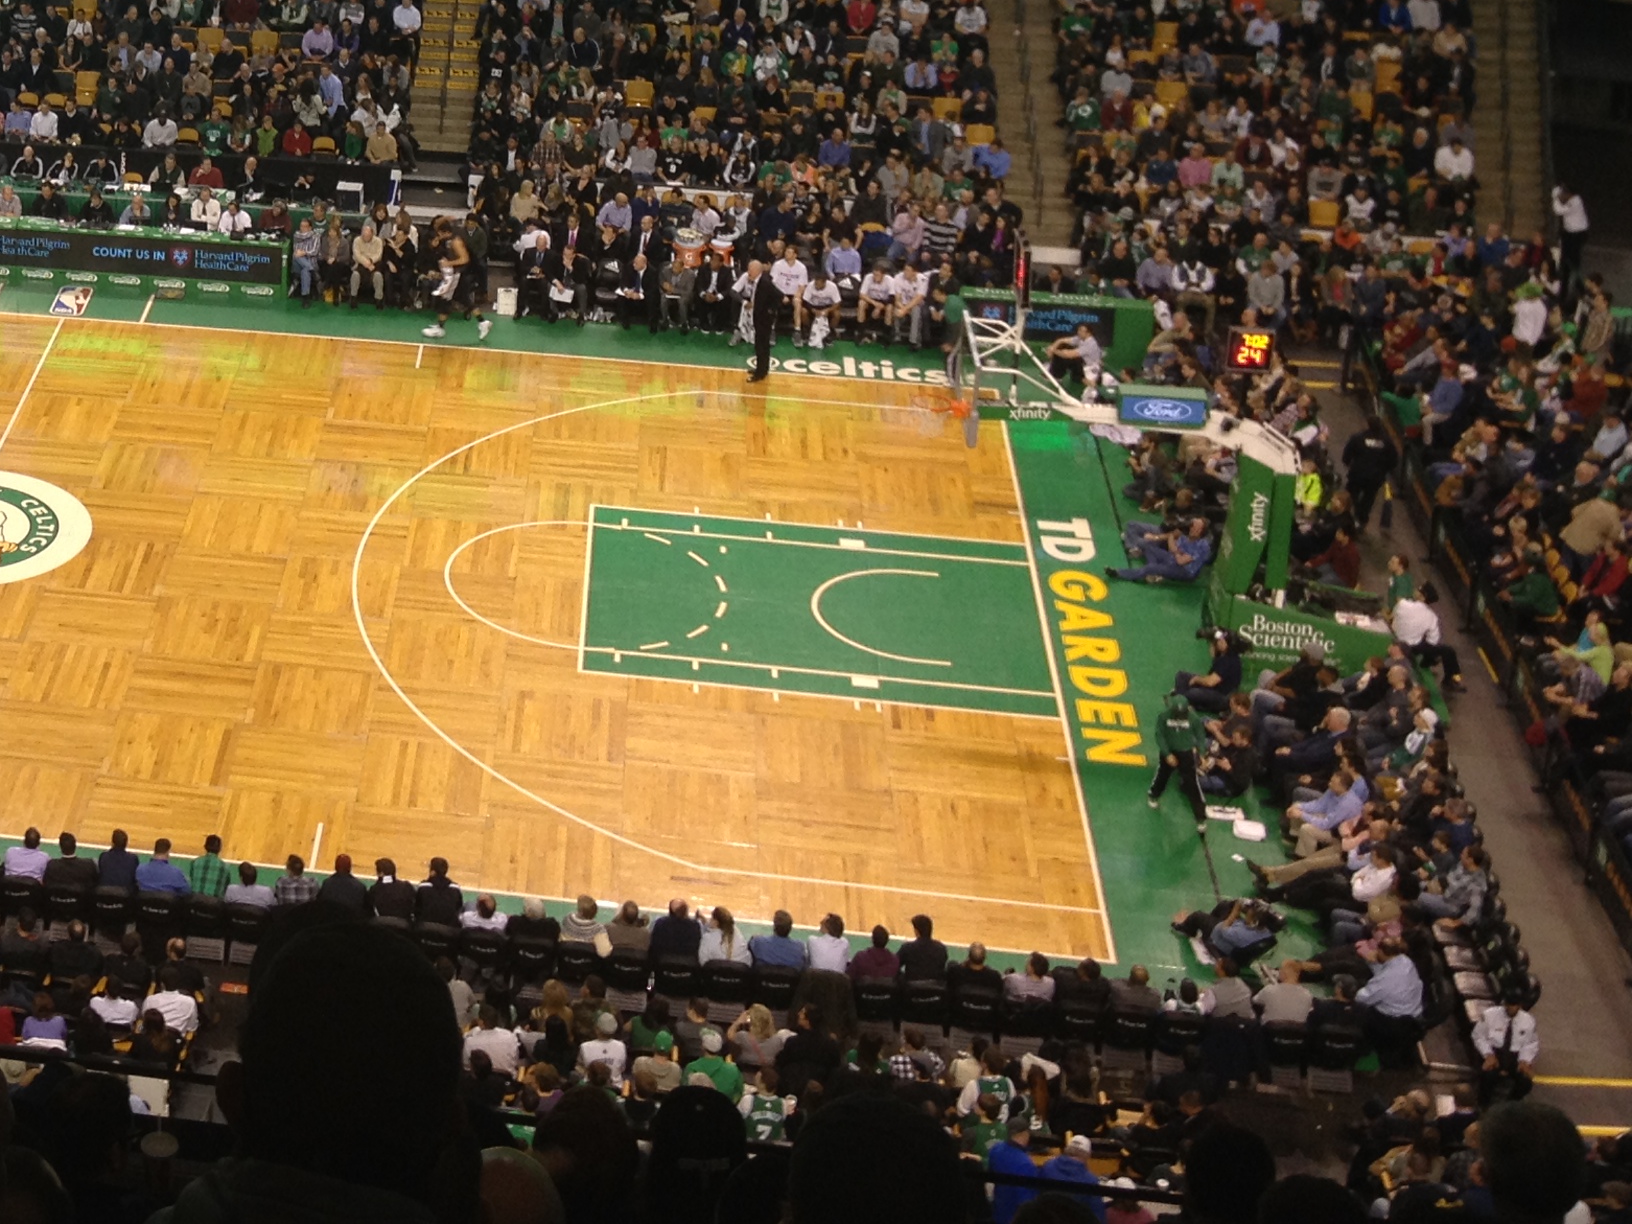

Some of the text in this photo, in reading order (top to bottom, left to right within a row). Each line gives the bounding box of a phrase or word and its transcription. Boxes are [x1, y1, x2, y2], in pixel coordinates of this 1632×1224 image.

[35, 237, 70, 250] Pilgrim
[92, 247, 166, 261] COUNT US IN
[194, 250, 270, 264] Harvard Pilgrim
[1058, 310, 1100, 323] Pilgrim
[1242, 334, 1269, 348] 7:02
[1237, 349, 1261, 364] 24
[1009, 408, 1051, 420] xfinity
[1143, 401, 1183, 418] Ford
[1248, 492, 1269, 542] xfinity
[20, 498, 55, 554] CELTICS
[1253, 614, 1313, 637] Boston
[1037, 518, 1147, 766] TD GARDEN
[756, 1124, 772, 1140] 7
